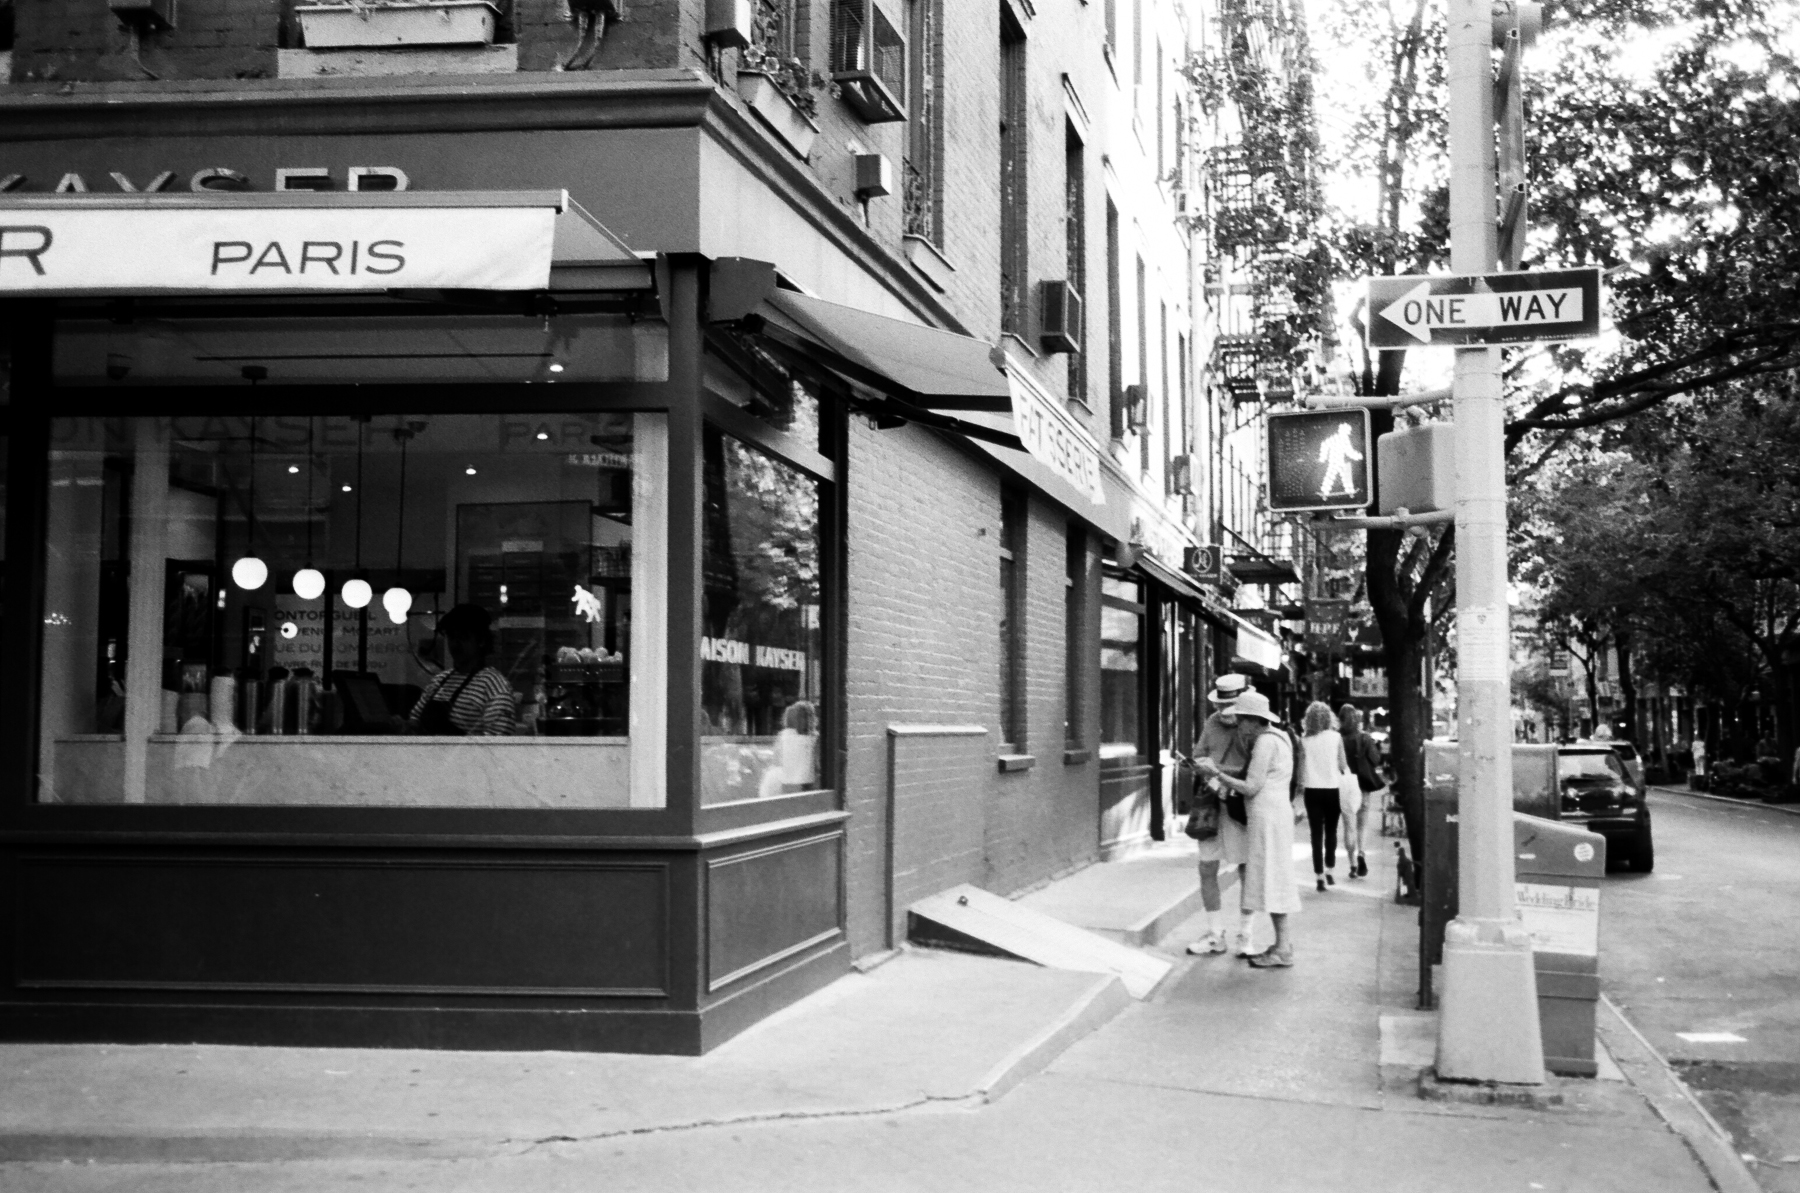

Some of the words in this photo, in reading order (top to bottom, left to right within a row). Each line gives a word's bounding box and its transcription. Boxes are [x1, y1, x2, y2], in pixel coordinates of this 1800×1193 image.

[210, 239, 407, 276] PARIS
[1403, 298, 1466, 326] ONE
[1499, 292, 1568, 322] WAY
[342, 626, 400, 636] MZART
